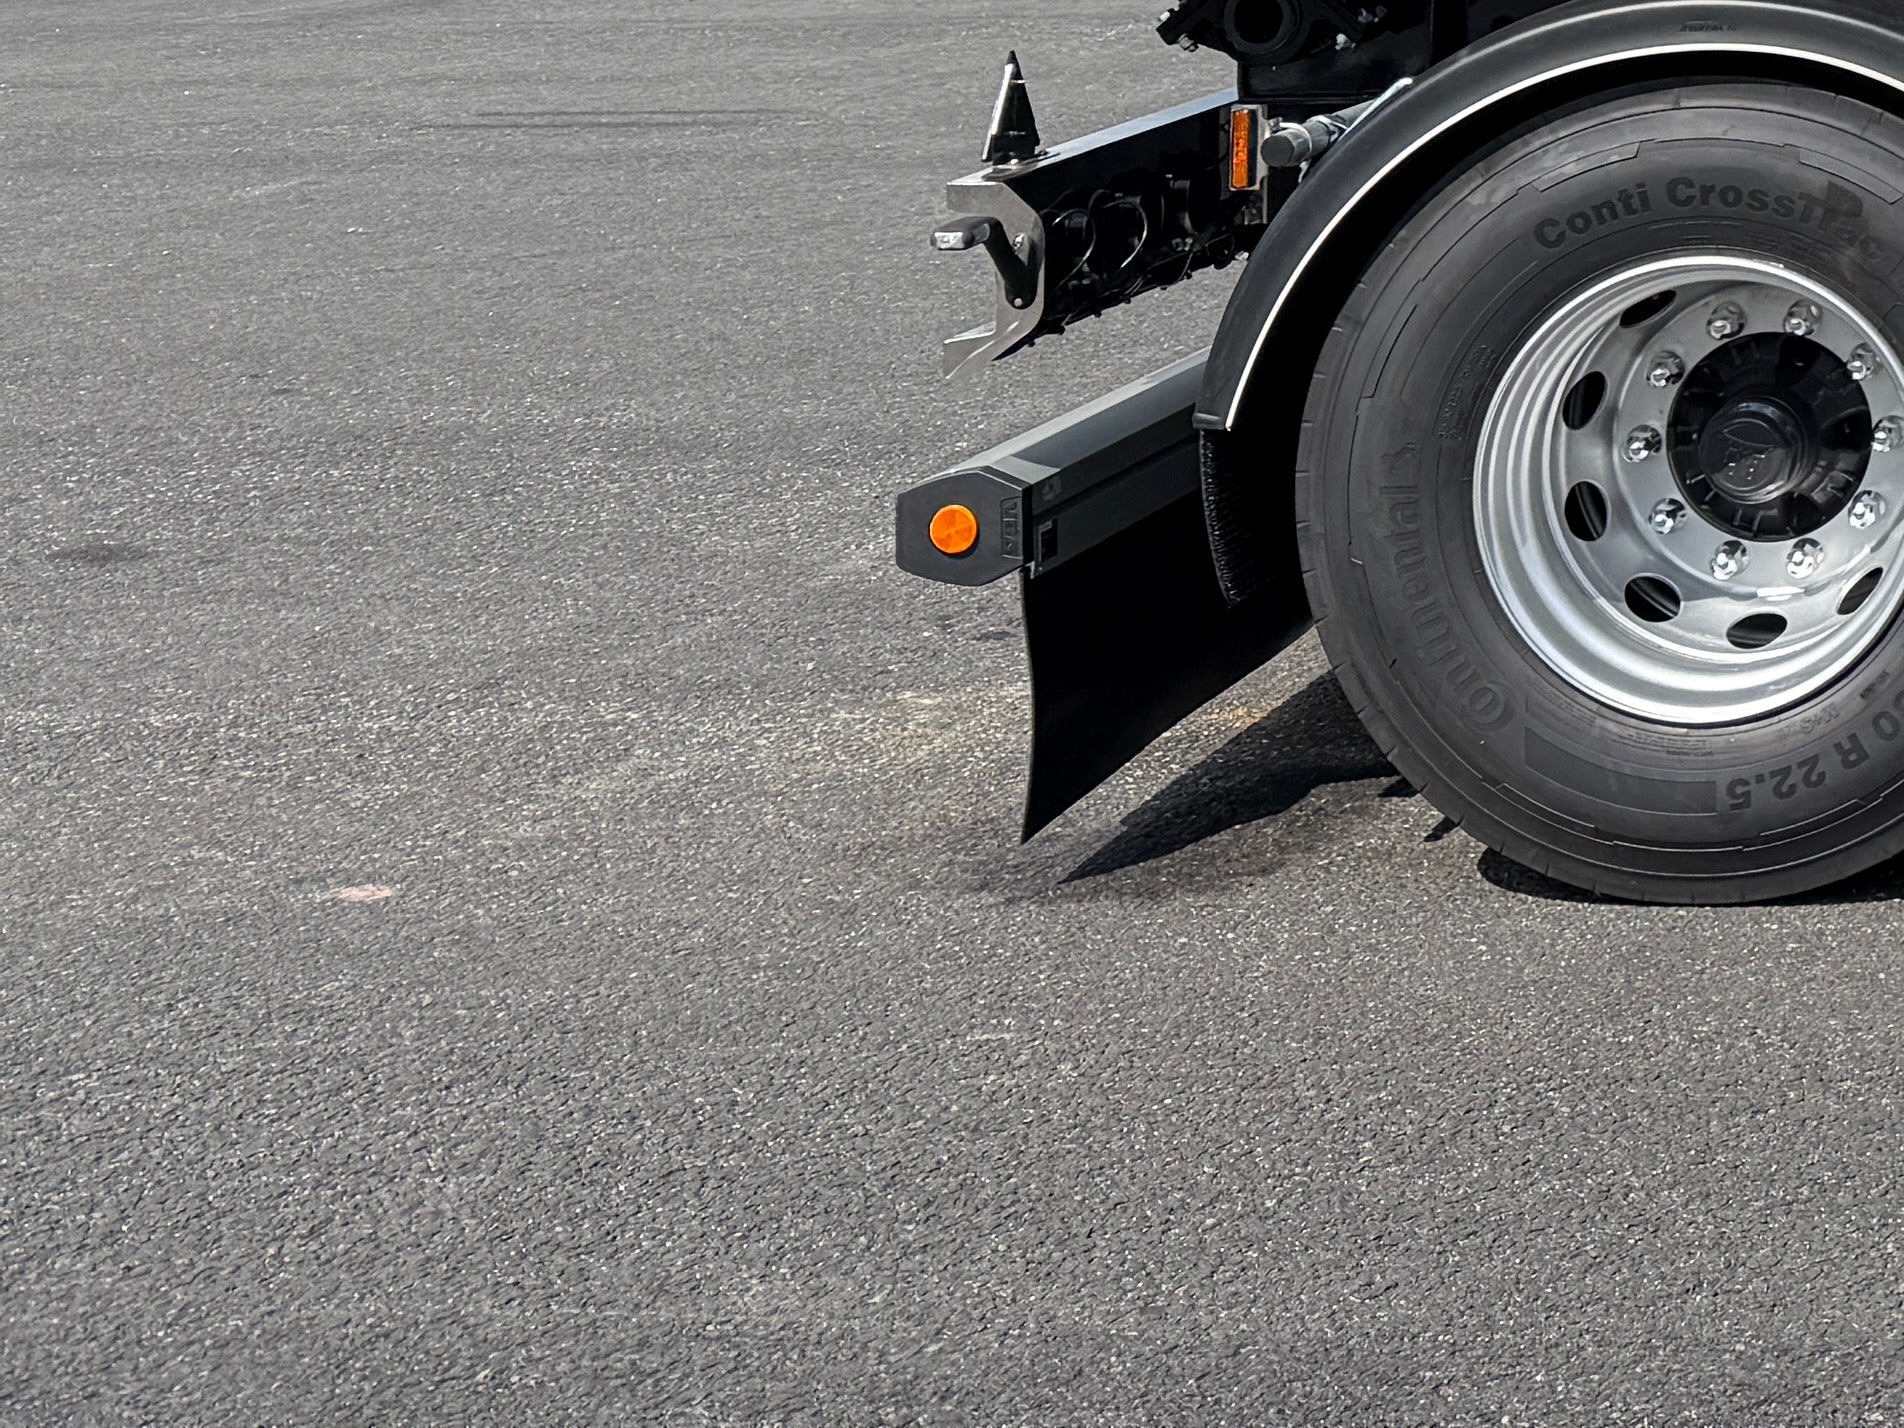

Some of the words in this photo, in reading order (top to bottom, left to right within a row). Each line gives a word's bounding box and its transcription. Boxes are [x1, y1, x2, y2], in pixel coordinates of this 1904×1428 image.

[1534, 181, 1651, 250] Conti
[1666, 177, 1885, 263] CrossTrac
[1378, 482, 1516, 735] Continental
[1726, 758, 1826, 809] 22.5
[1835, 736, 1869, 770] R
